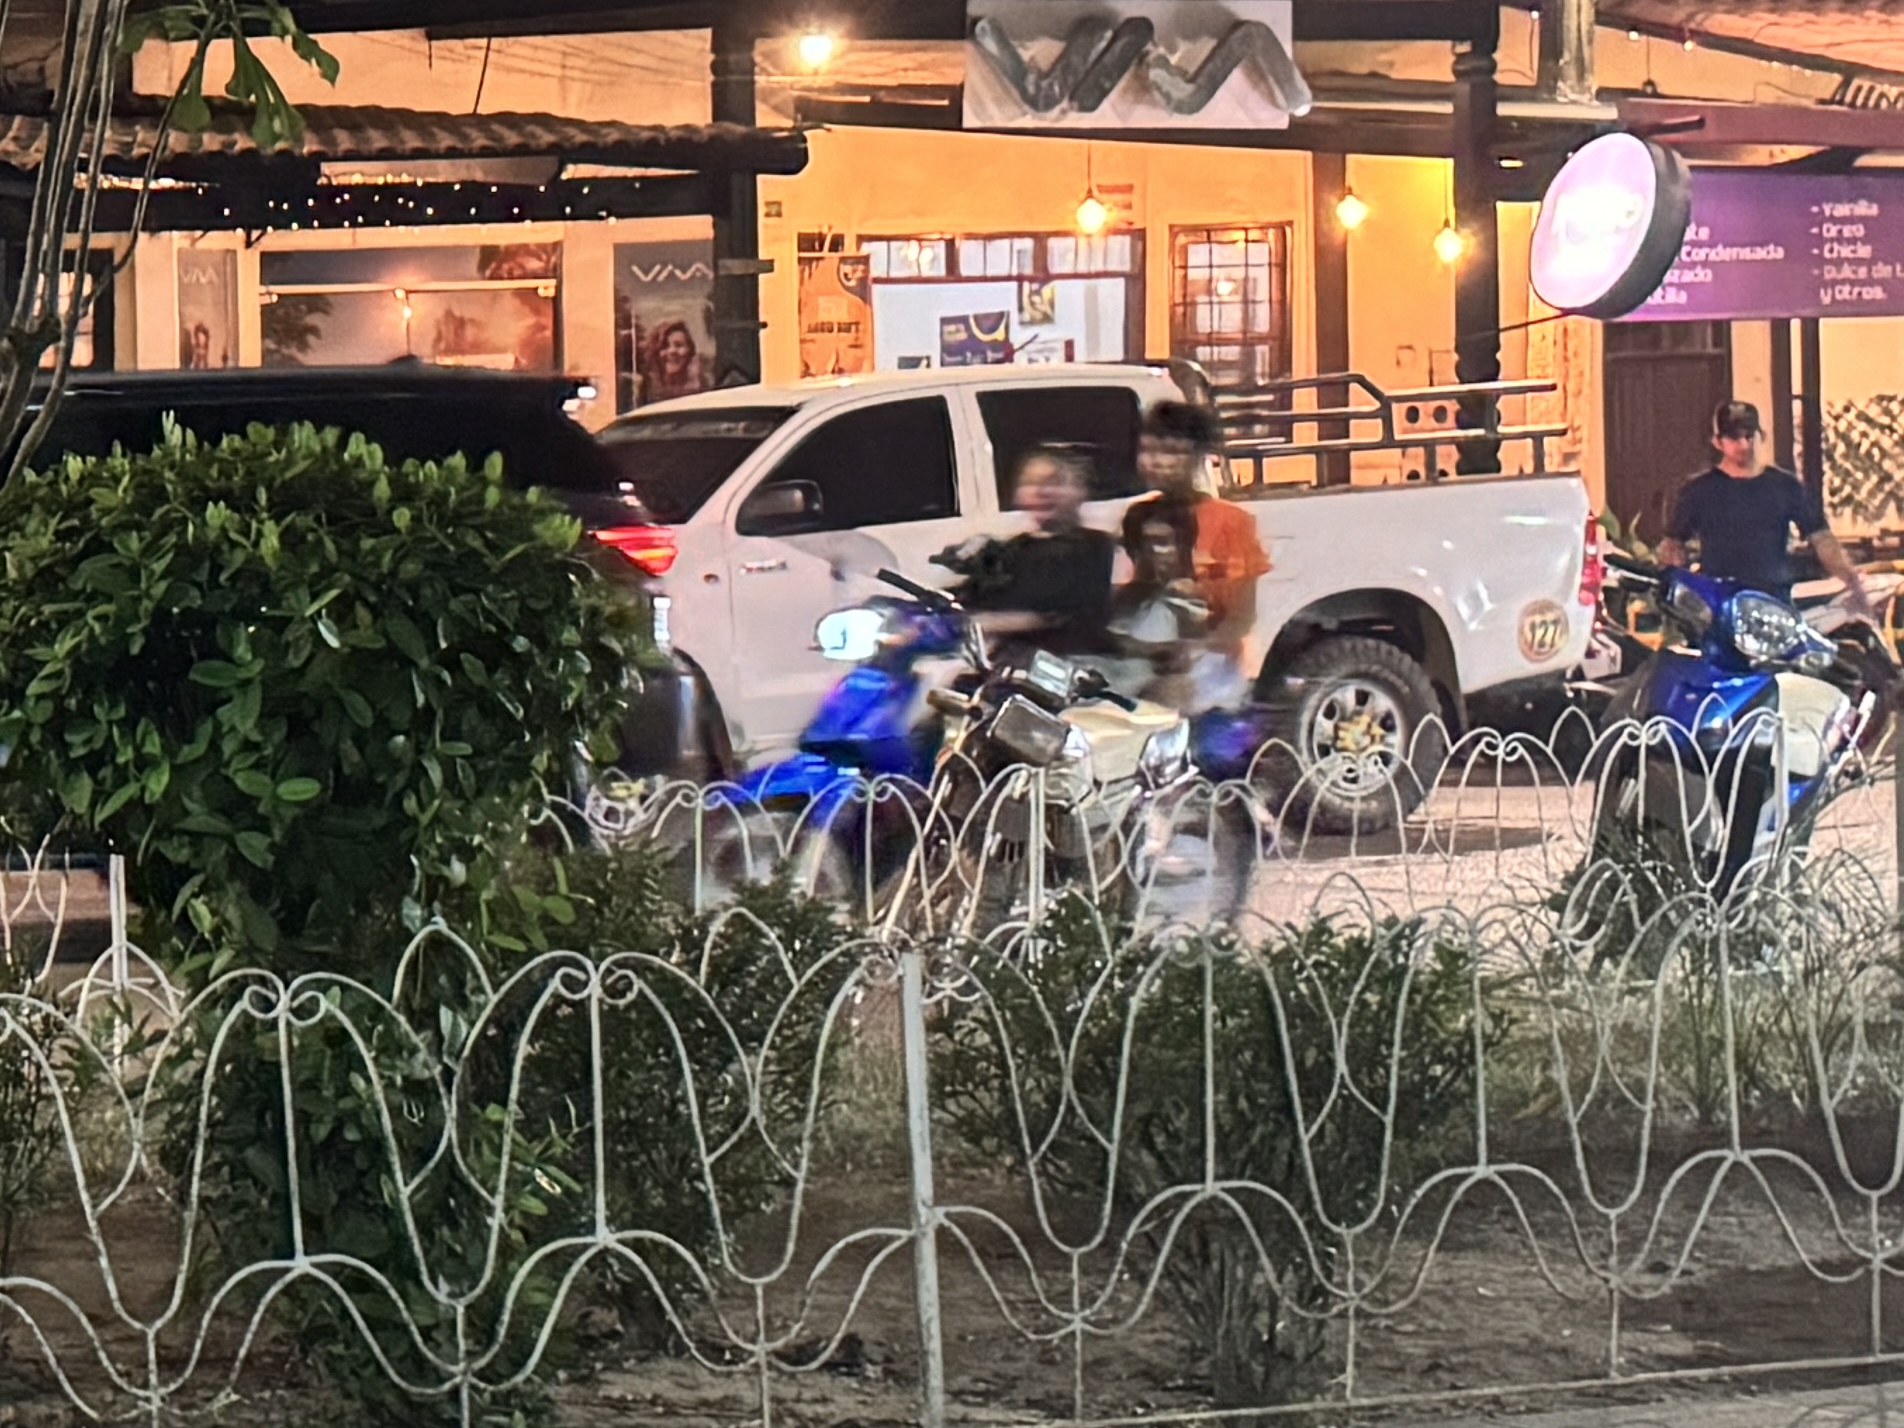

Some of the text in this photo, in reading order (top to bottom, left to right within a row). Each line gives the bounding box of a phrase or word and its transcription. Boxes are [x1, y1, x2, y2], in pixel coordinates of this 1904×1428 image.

[1822, 223, 1865, 238] Oreo
[1823, 241, 1872, 259] Chicle
[1529, 618, 1562, 651] 127
